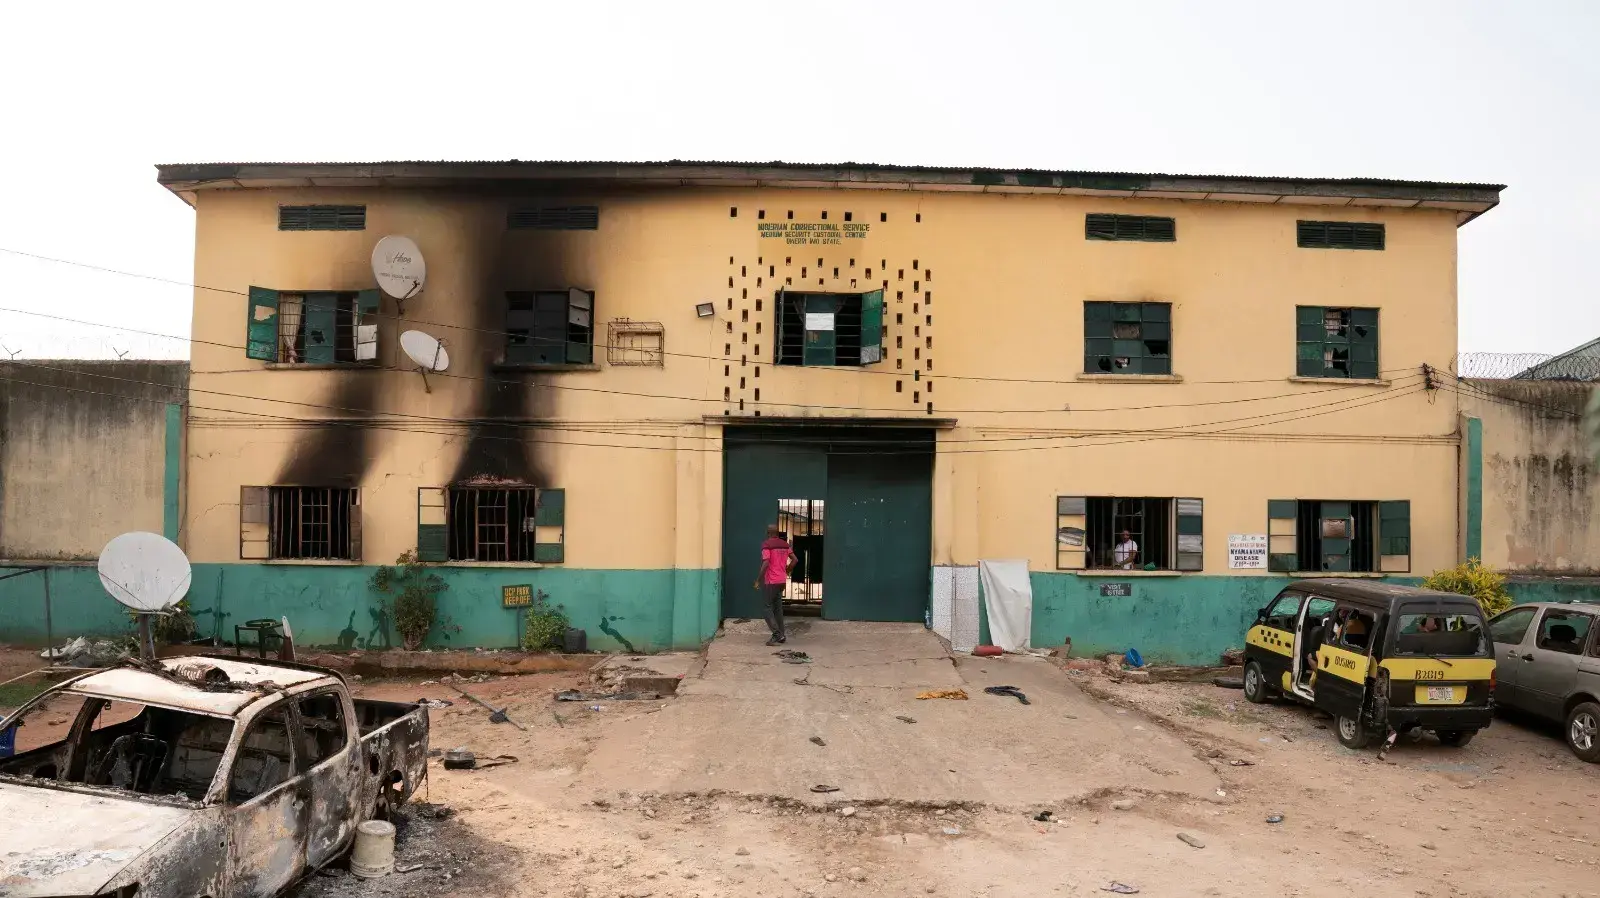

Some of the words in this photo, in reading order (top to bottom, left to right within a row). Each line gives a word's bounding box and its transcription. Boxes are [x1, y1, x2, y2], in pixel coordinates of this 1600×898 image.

[758, 223, 787, 231] NIGERIAN
[790, 223, 840, 231] CORRECTIONAL
[843, 223, 870, 232] SERVICE
[504, 596, 519, 606] KEEP
